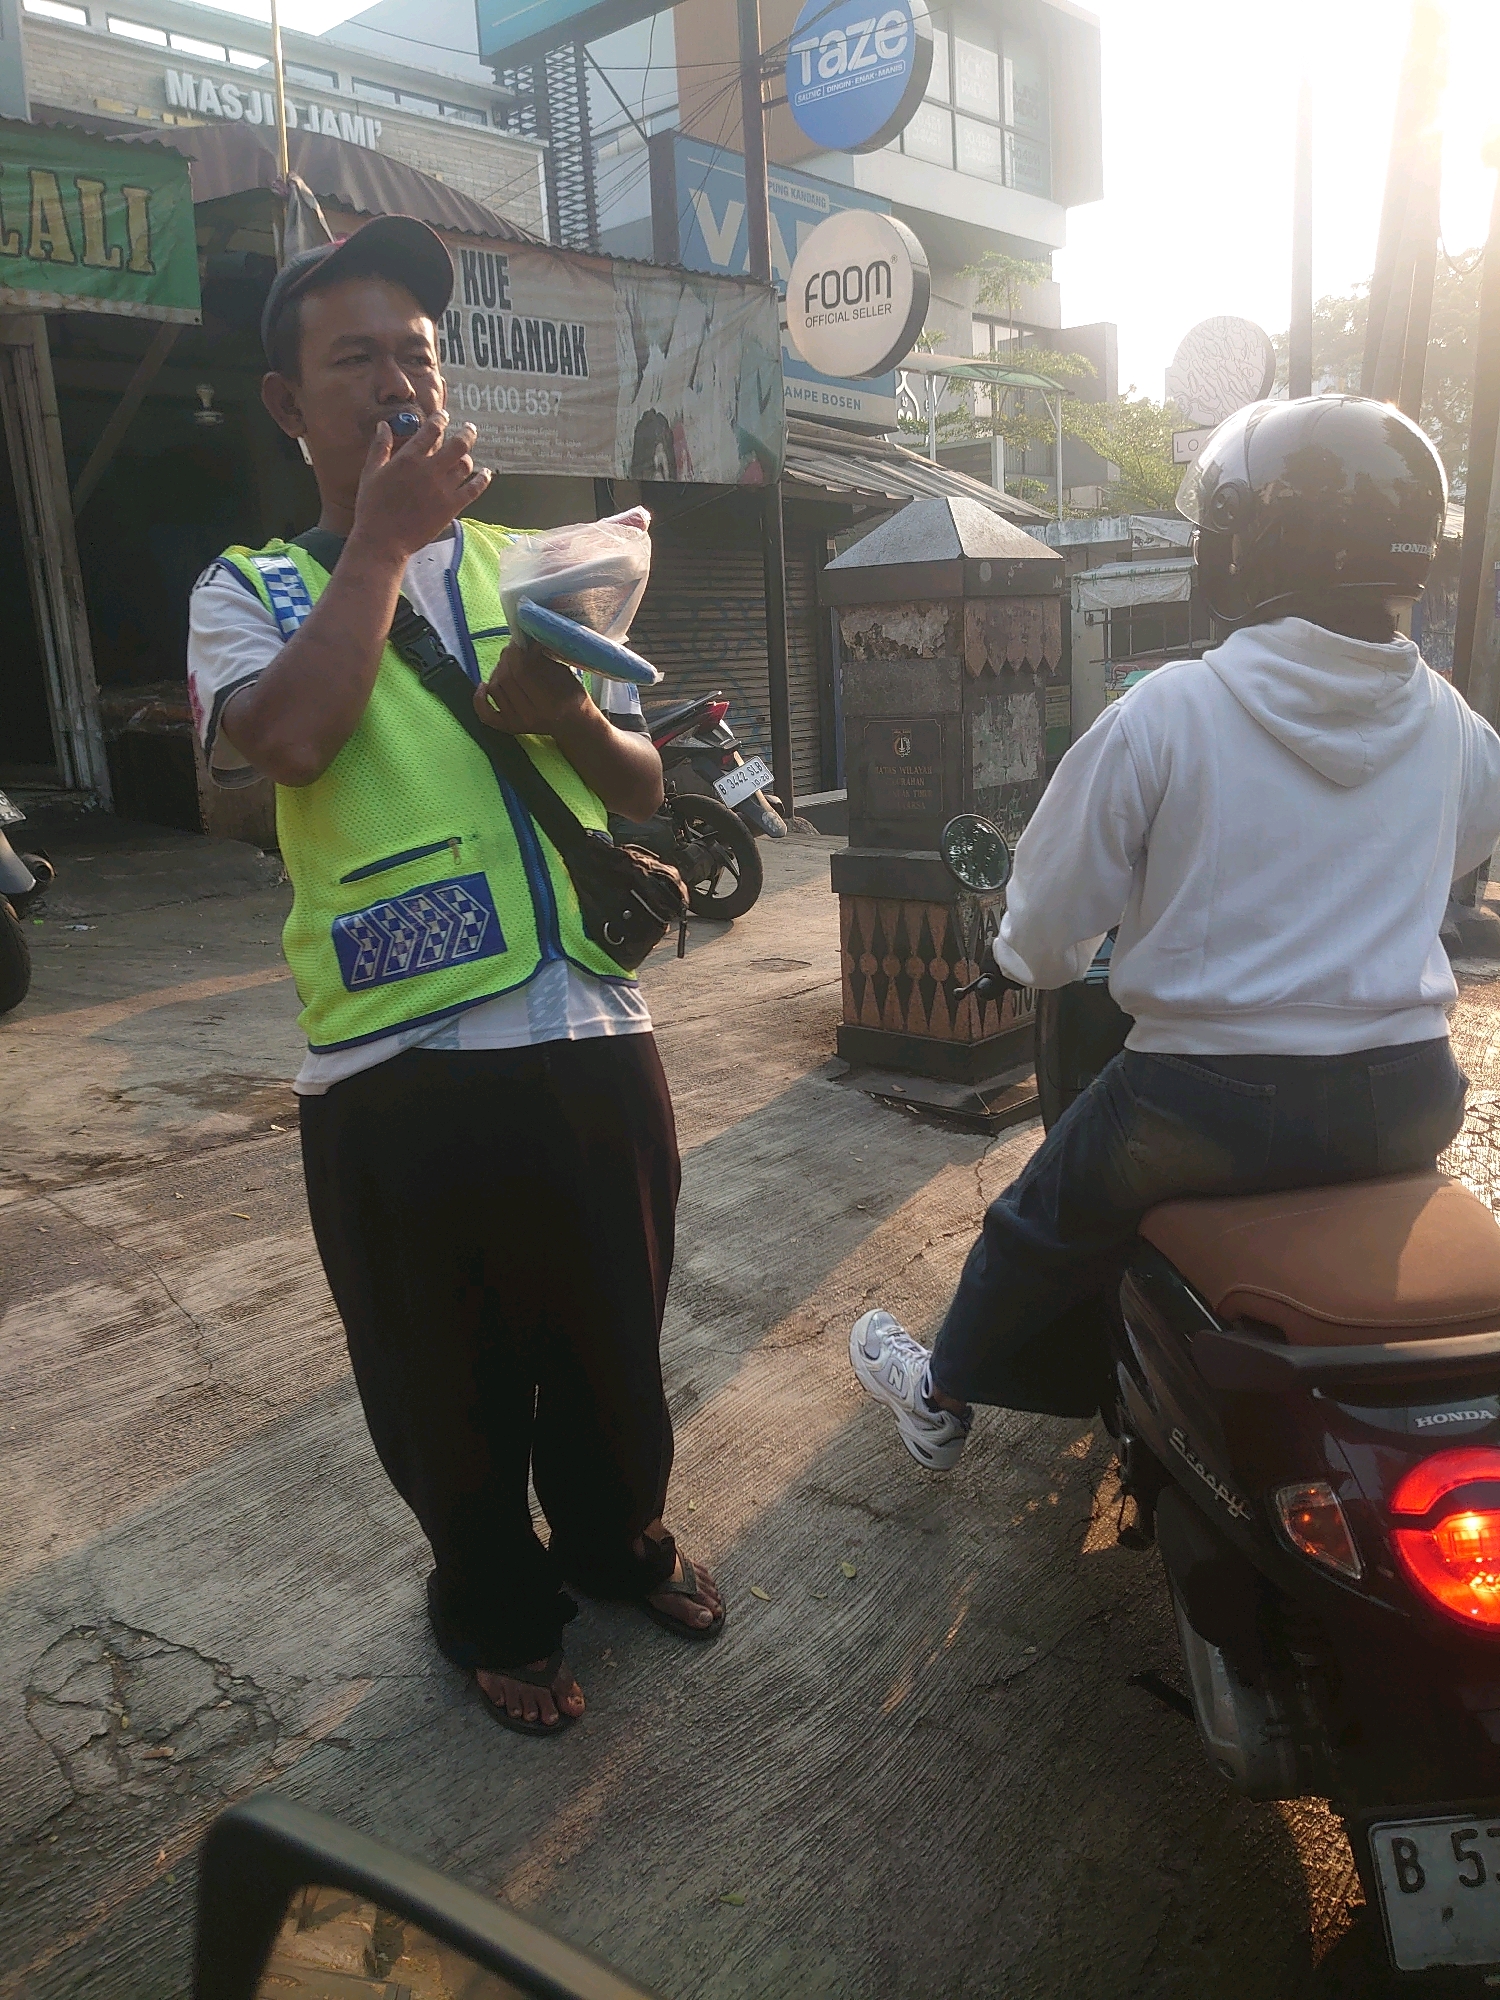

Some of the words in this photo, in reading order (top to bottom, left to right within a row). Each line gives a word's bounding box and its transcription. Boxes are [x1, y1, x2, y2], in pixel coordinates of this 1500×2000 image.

[854, 73, 875, 84] ENAK
[878, 64, 903, 77] MANIS
[165, 69, 297, 129] MASJID
[790, 187, 827, 208] KANDANG
[460, 249, 512, 311] KUE
[804, 260, 892, 313] FOOM
[805, 311, 850, 328] OFFICIAL
[852, 303, 892, 320] SELLER
[471, 311, 589, 378] CILANDAK
[525, 388, 563, 416] 537
[784, 385, 818, 403] AMPE
[822, 393, 861, 411] BOSEN
[726, 771, 748, 789] 3442
[746, 761, 763, 776] SLB
[1414, 1409, 1498, 1429] HONDA
[1391, 1836, 1426, 1894] B
